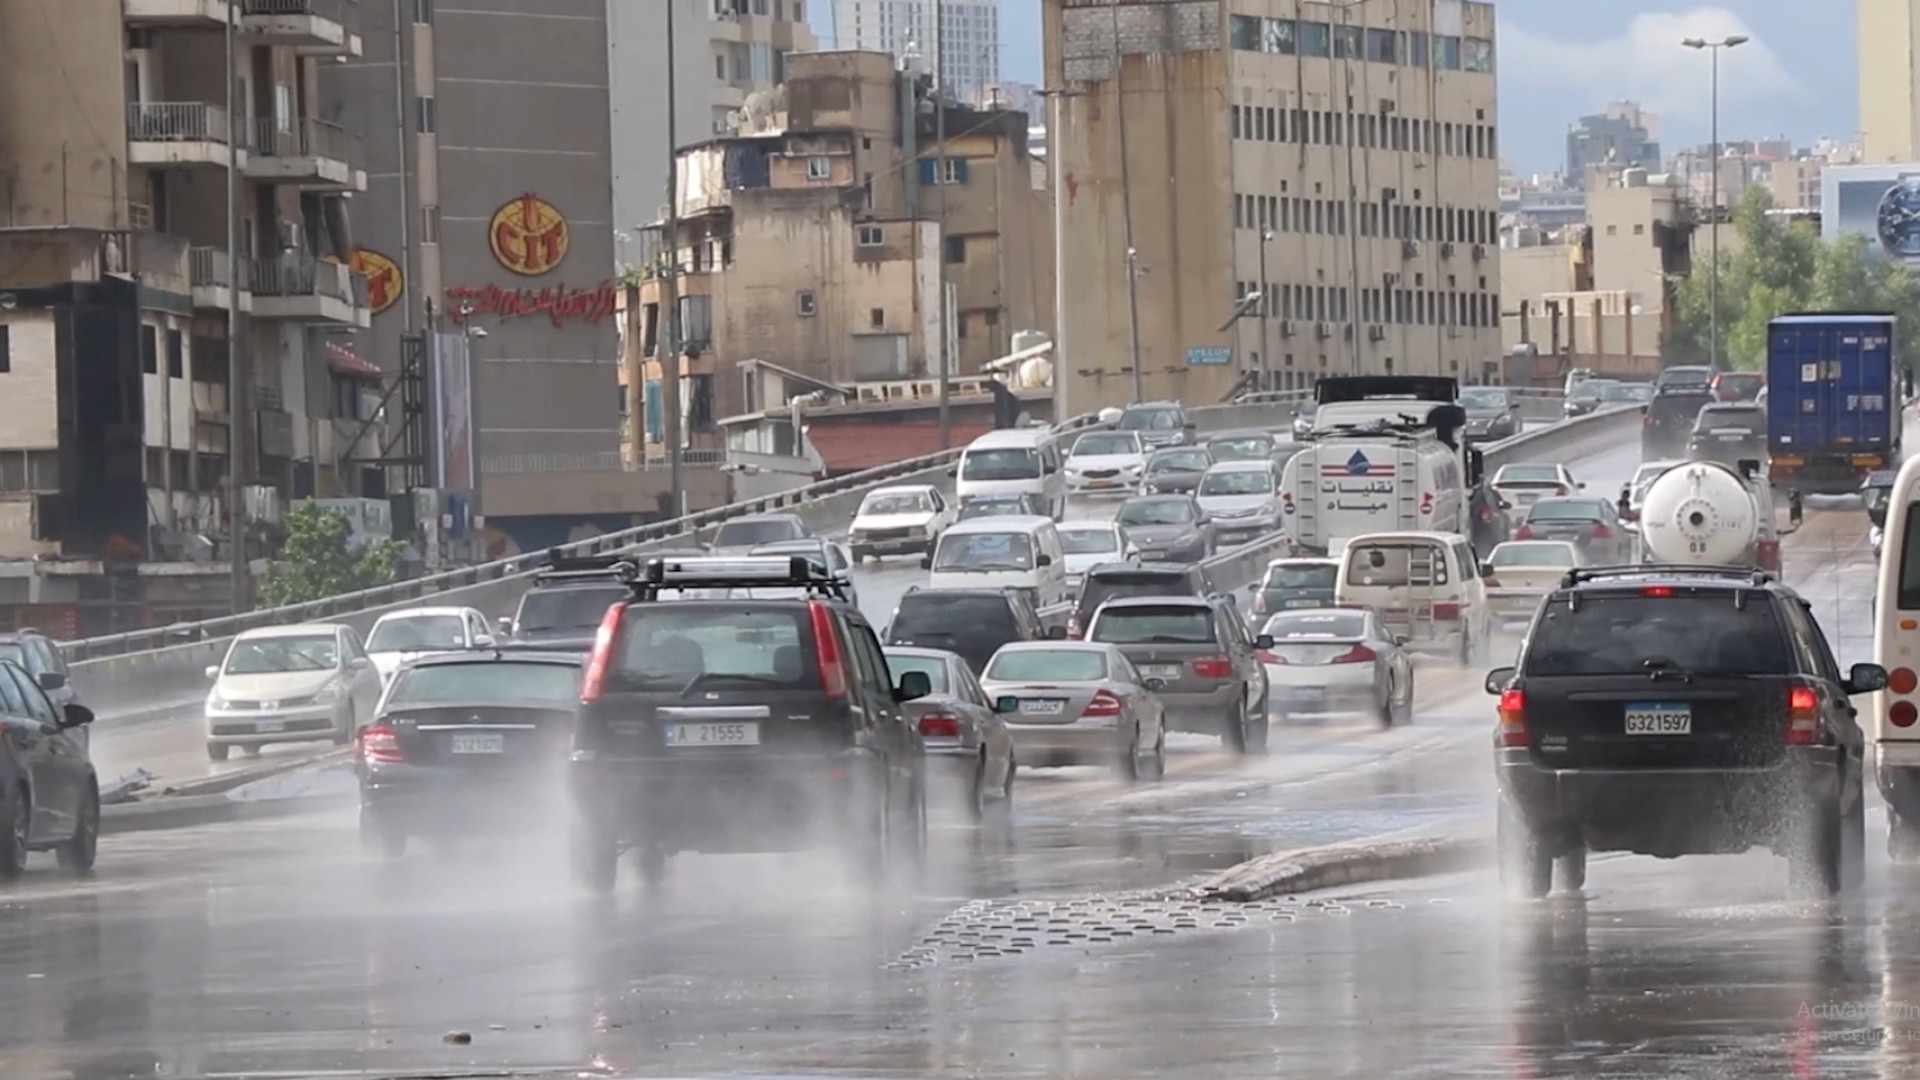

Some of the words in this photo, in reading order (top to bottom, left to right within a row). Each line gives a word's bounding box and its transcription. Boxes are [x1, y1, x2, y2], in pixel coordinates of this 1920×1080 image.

[496, 221, 564, 269] CIT
[1321, 480, 1394, 498] نقليات
[1326, 499, 1388, 515] مياه
[1626, 714, 1690, 732] G321597
[677, 725, 688, 741] A
[701, 724, 745, 741] 21555
